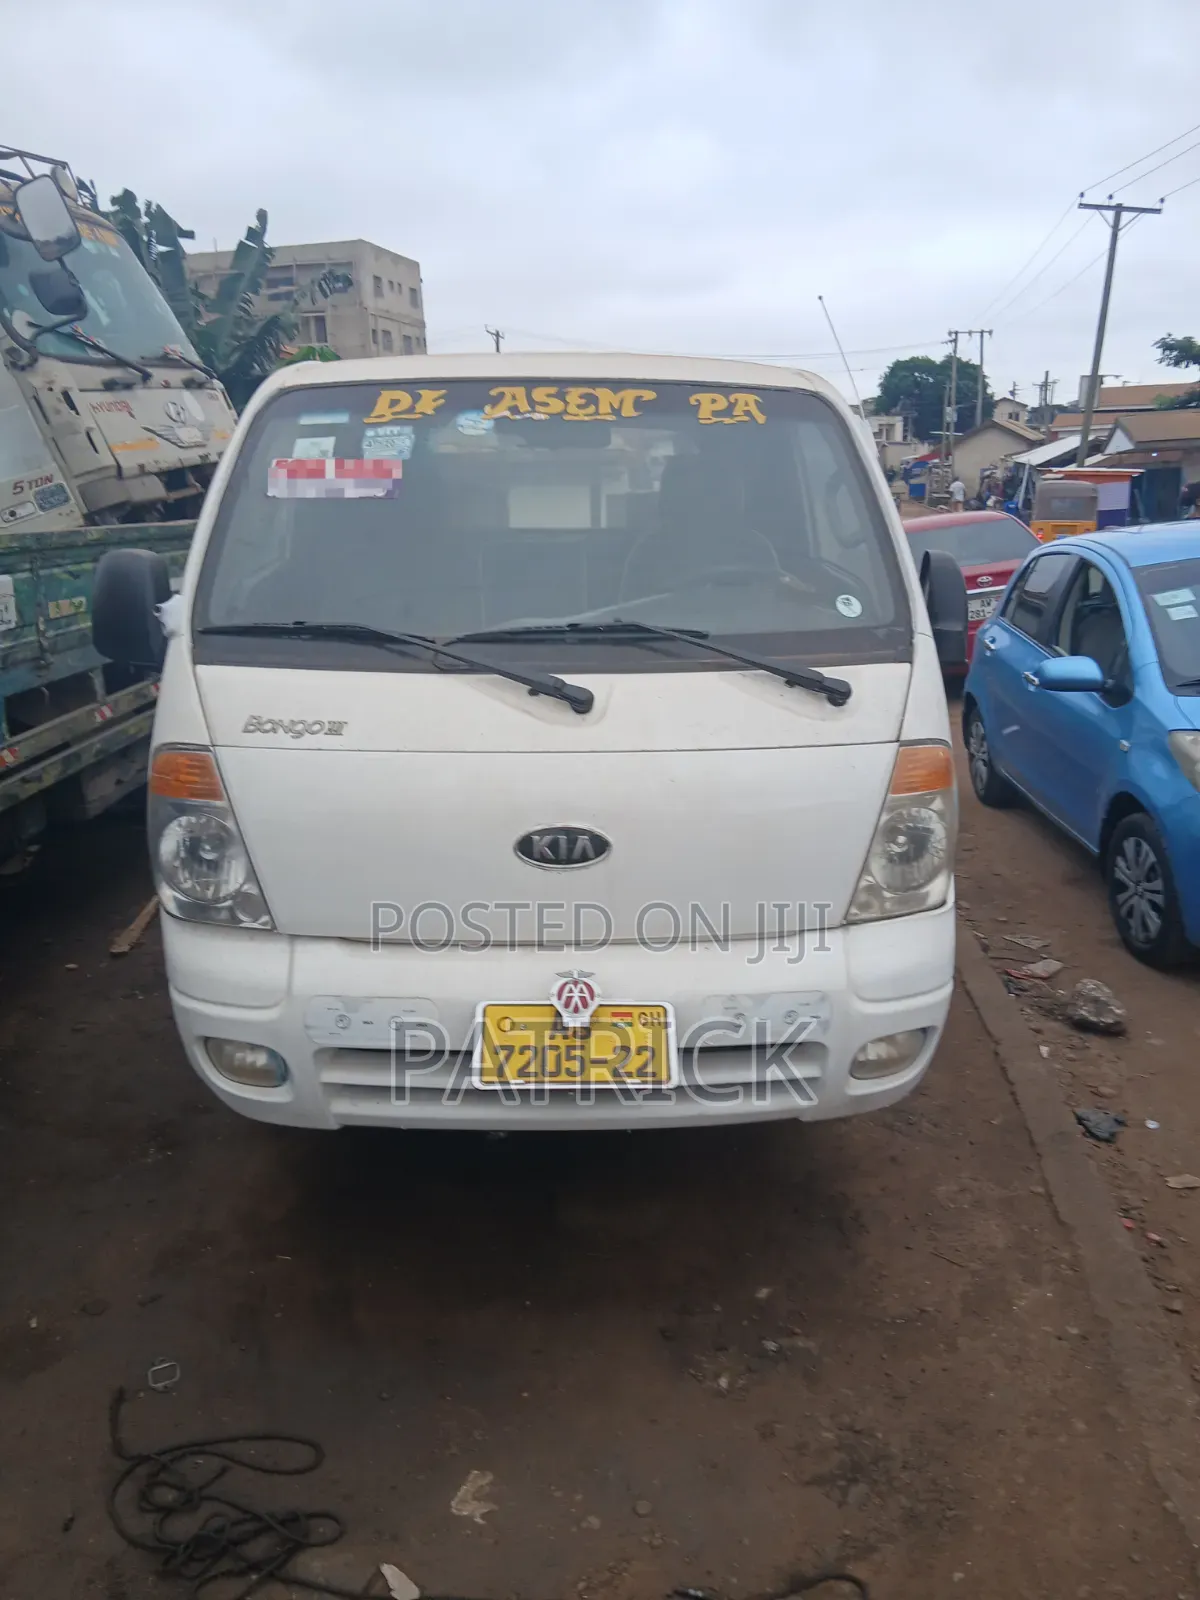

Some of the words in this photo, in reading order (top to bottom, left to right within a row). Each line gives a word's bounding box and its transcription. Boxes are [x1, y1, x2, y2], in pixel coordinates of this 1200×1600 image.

[481, 386, 657, 421] ASEM
[689, 392, 767, 424] PA
[13, 480, 24, 495] 5
[531, 835, 596, 860] KIA
[494, 1044, 657, 1079] 7205-22
